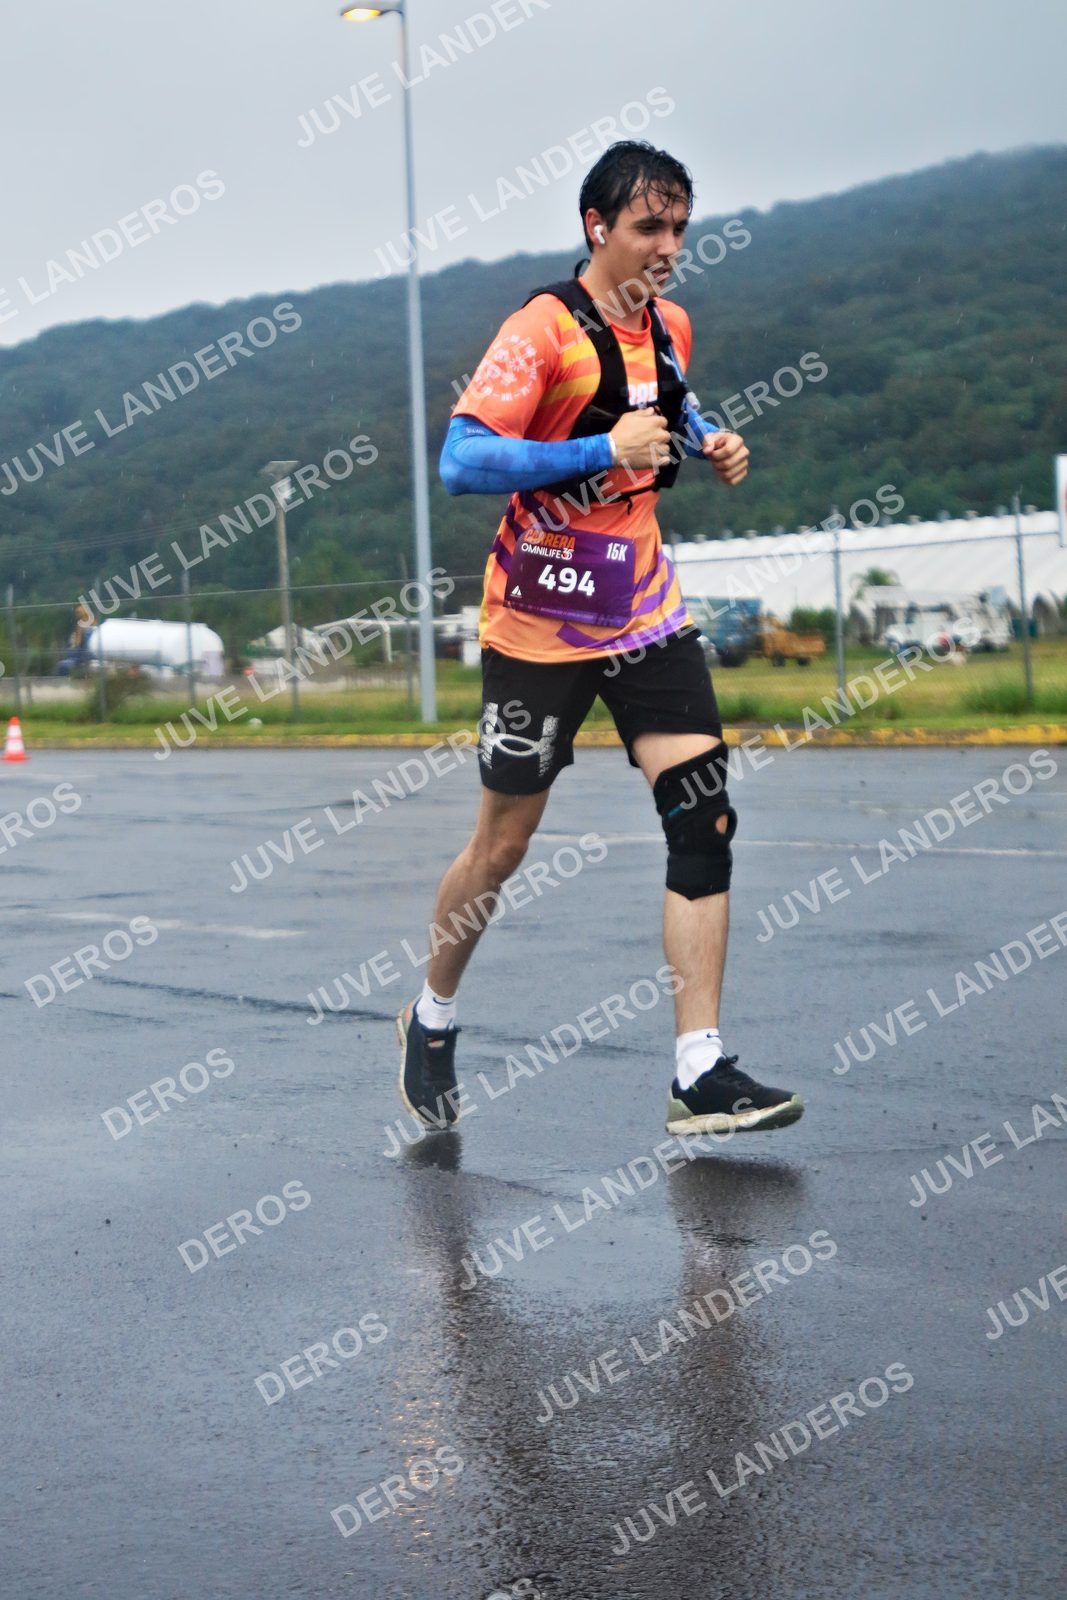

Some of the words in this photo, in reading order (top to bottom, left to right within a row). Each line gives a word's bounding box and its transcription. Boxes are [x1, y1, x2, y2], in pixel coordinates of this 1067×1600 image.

[524, 529, 576, 549] CARRERA
[521, 543, 562, 559] OMNILIFE
[606, 542, 628, 562] 15K
[538, 564, 595, 597] 494
